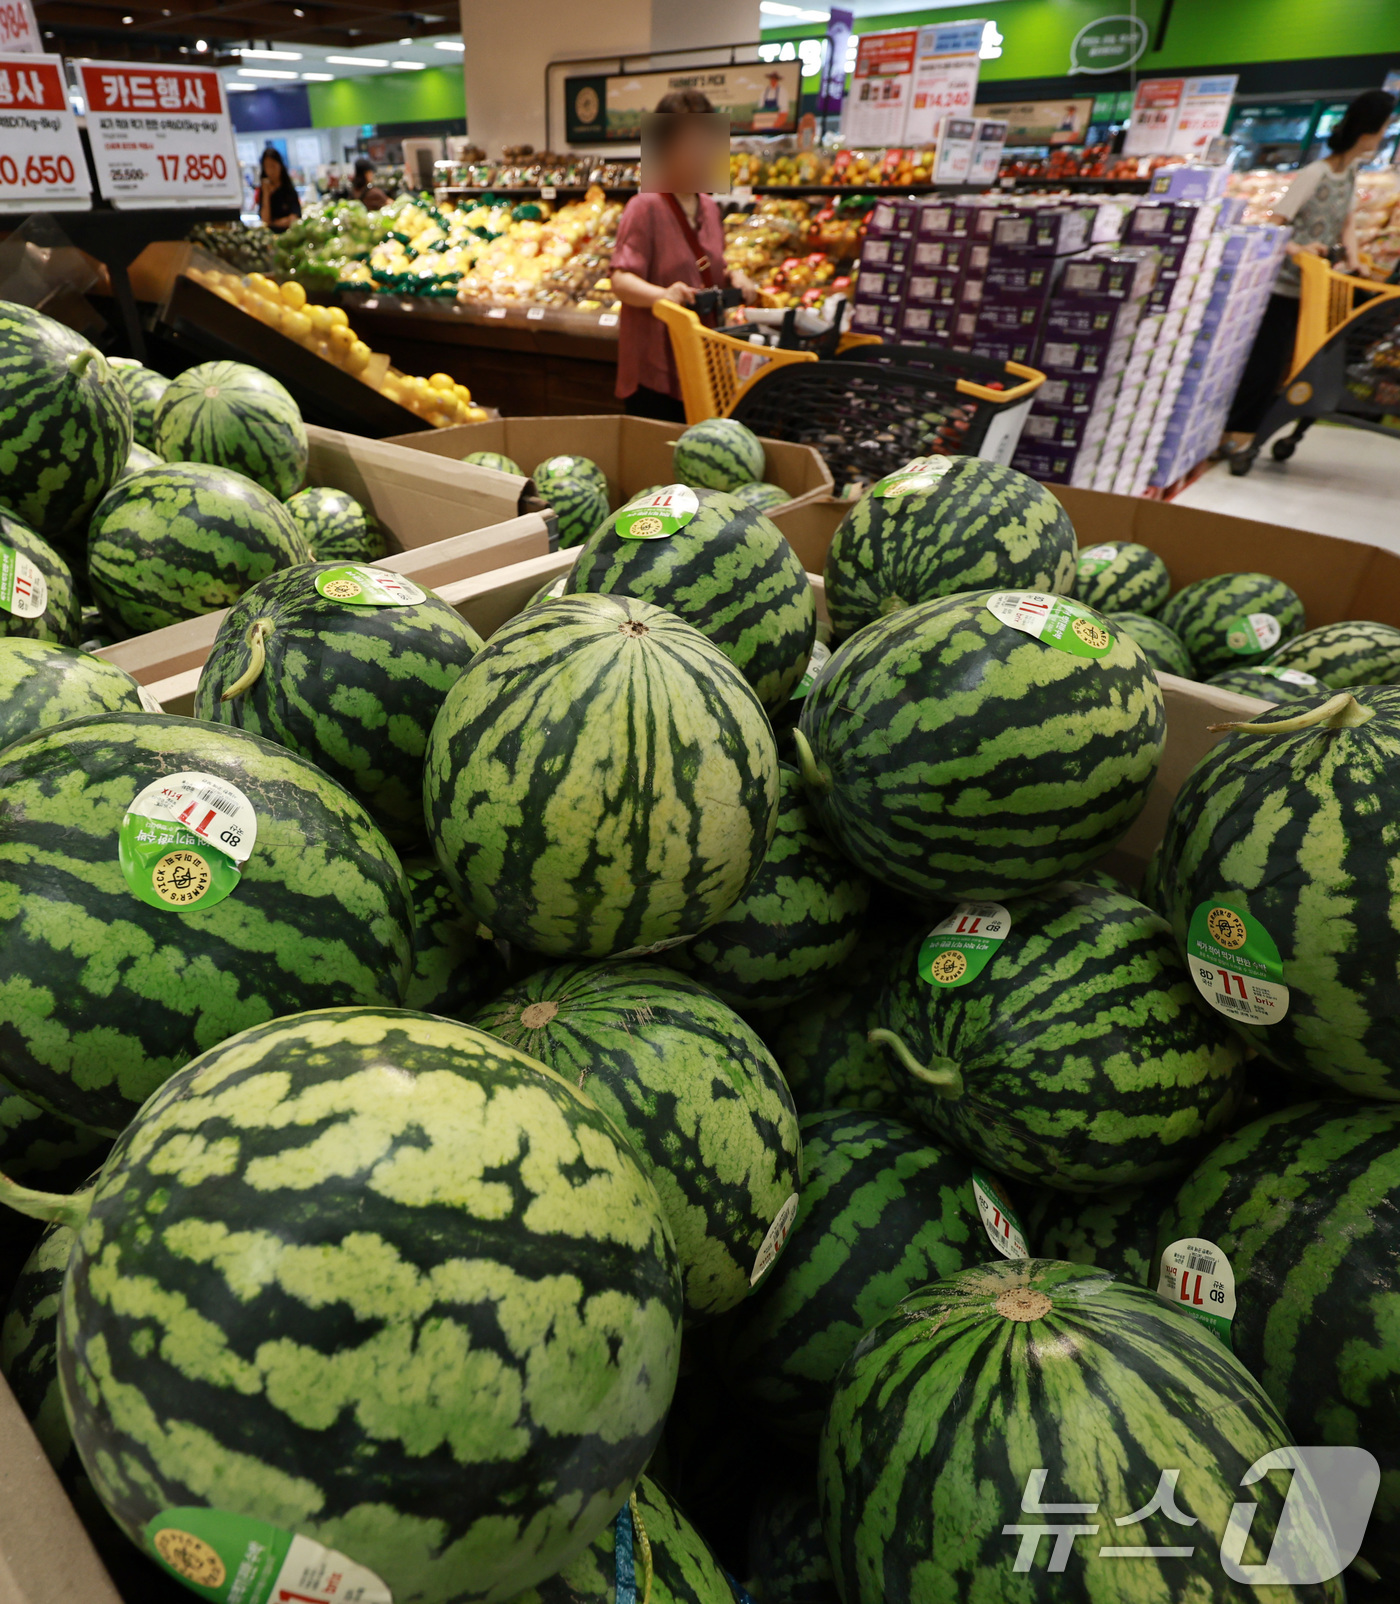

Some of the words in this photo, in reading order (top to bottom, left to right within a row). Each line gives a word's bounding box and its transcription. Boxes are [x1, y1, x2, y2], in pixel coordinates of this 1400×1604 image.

[101, 75, 206, 109] 카드행사
[0, 154, 75, 187] 0,650
[157, 154, 227, 183] 17,850
[652, 496, 672, 506] 11
[16, 577, 31, 596] 11
[376, 579, 401, 590] 11
[1019, 601, 1049, 616] 11
[161, 788, 182, 800] brix
[177, 800, 207, 837] 11
[134, 830, 158, 844] 수박
[220, 830, 241, 847] 8D
[229, 824, 244, 836] 국산
[175, 833, 196, 846] 먹기
[164, 853, 202, 867] 파머스픽
[156, 869, 168, 894] PICK
[170, 872, 208, 902] FARMER'S
[956, 916, 982, 934] 11
[986, 924, 1001, 932] 8D
[1210, 908, 1232, 928] FARMER'S
[1234, 918, 1244, 938] PICK
[1208, 945, 1222, 956] 적어
[1221, 950, 1236, 963] 먹기
[1236, 956, 1252, 968] 편한
[940, 963, 965, 982] FARMER'S
[1200, 968, 1214, 981] 8D
[1217, 970, 1248, 1000] 11
[1255, 996, 1275, 1008] brix
[993, 1206, 1010, 1238] 11
[1181, 1271, 1203, 1305] 11
[1213, 1280, 1224, 1290] 국산
[1210, 1289, 1224, 1304] 8D
